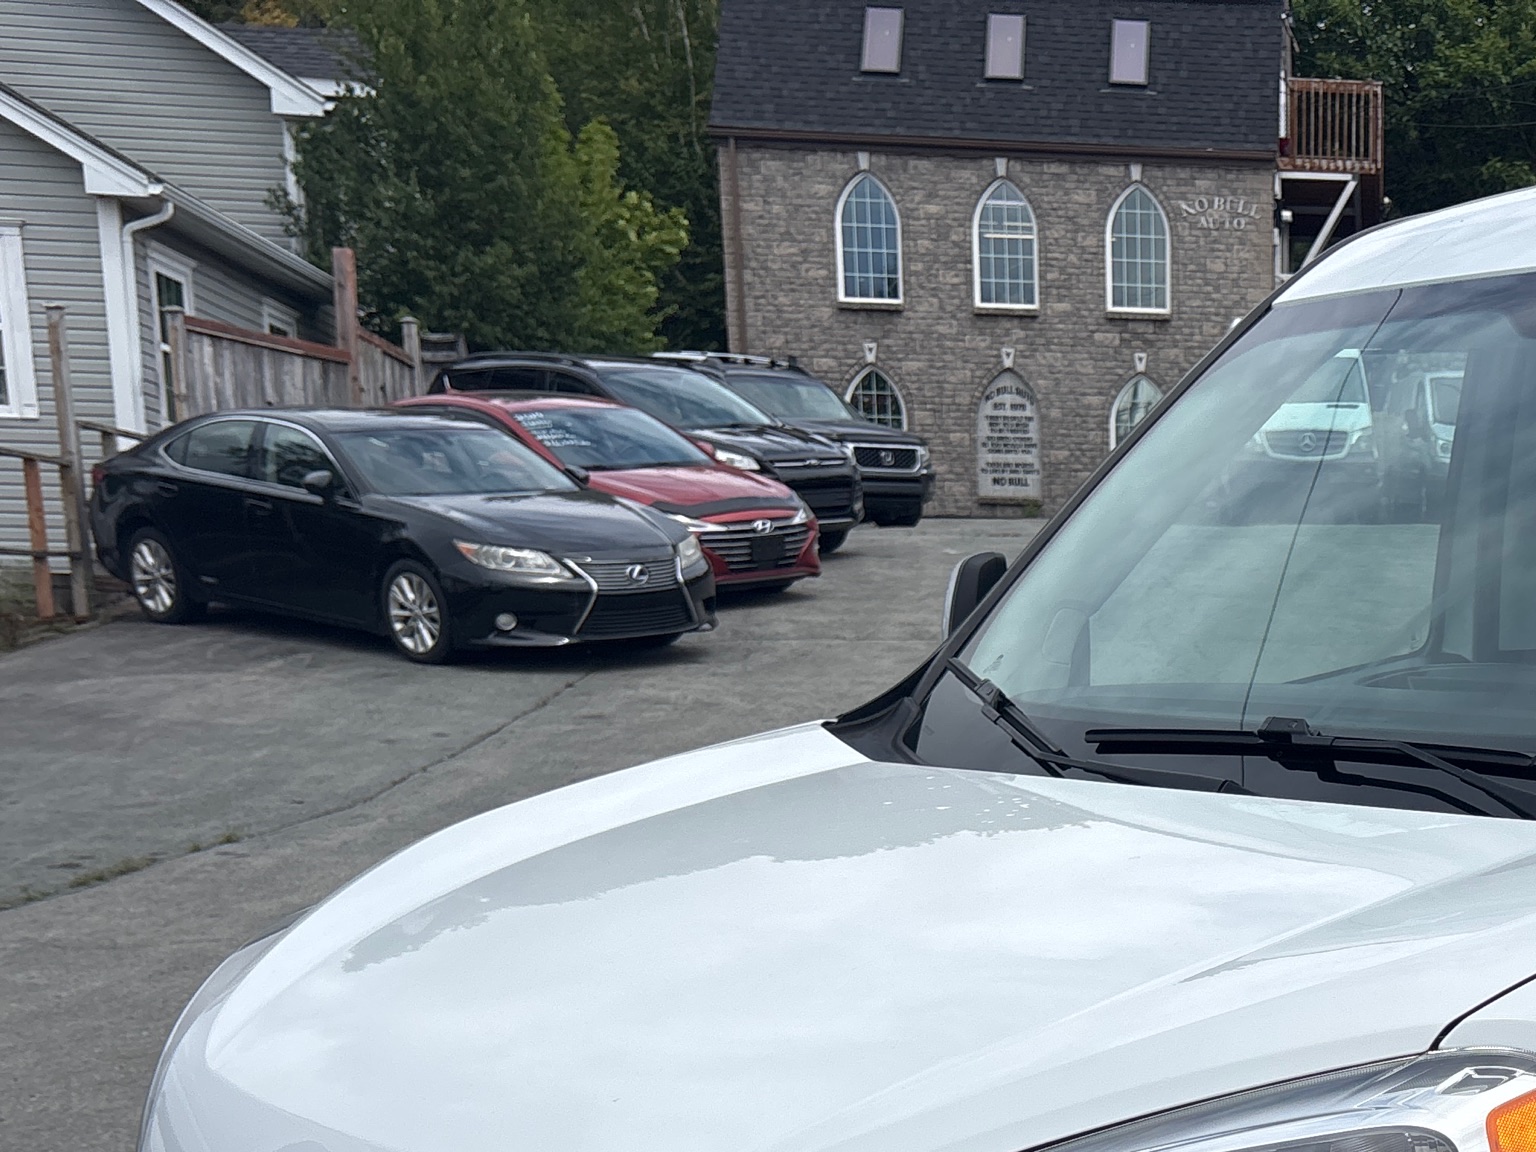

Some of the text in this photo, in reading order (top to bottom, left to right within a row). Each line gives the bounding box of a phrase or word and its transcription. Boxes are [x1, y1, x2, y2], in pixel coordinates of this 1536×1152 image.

[1178, 196, 1208, 217] NO
[1198, 215, 1246, 230] AUTO
[992, 476, 1007, 486] NO
